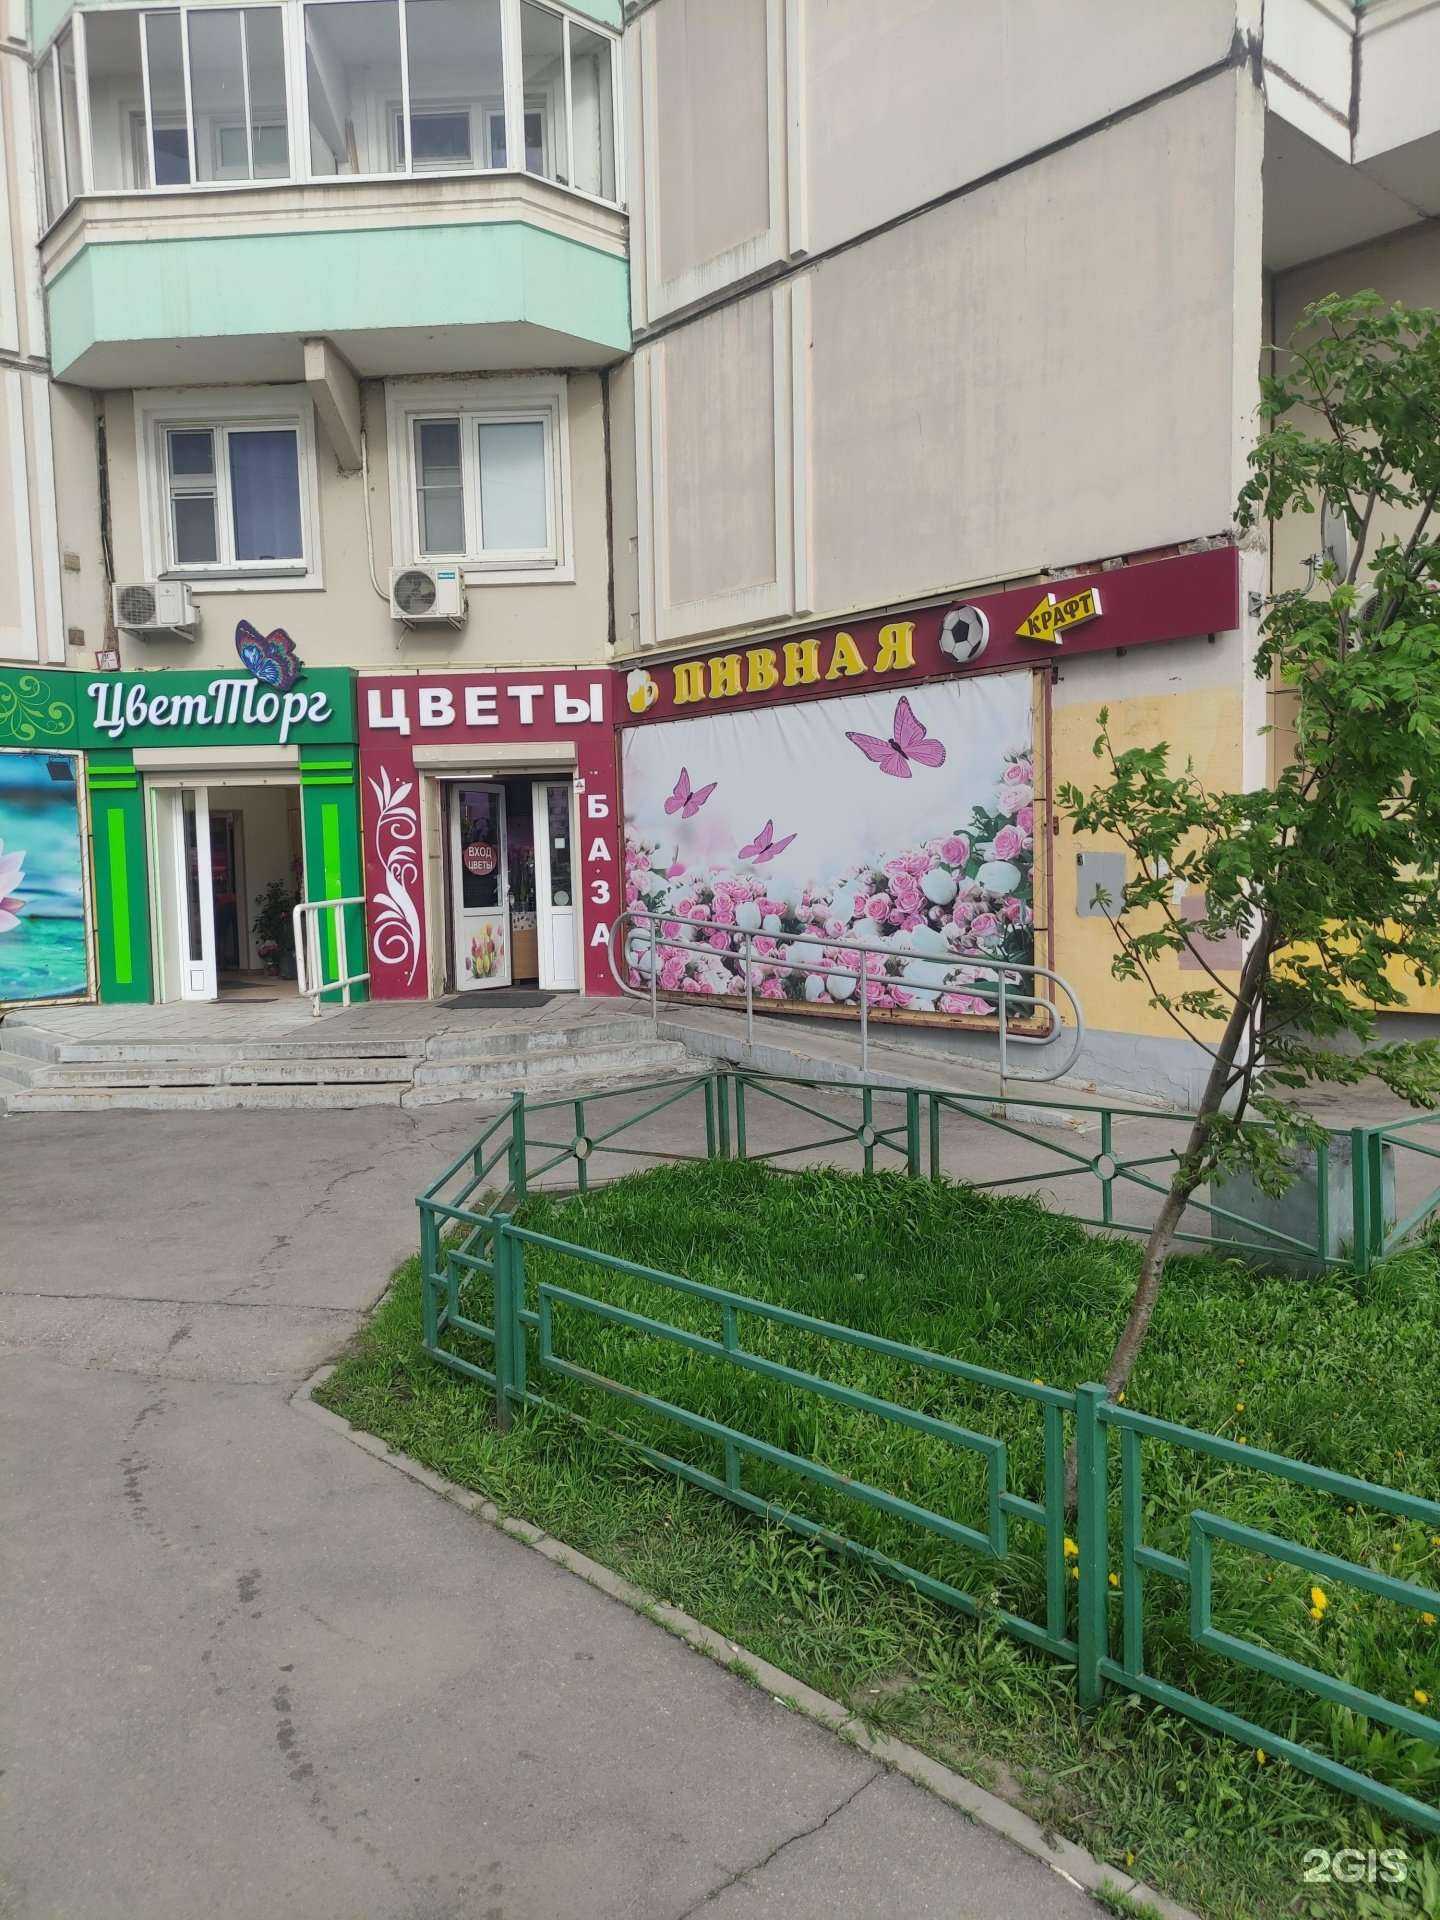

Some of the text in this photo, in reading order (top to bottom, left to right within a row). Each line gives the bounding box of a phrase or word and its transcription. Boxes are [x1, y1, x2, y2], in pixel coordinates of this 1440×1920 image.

[1027, 594, 1091, 635] КРАФТ
[672, 621, 916, 705] ПИВНАЯ
[88, 678, 333, 743] ЦветТорг
[367, 683, 604, 735] ЦВЕТЫ
[468, 846, 492, 859] ВХОД
[468, 860, 493, 870] ЦВЕТЫ
[587, 794, 612, 947] БАЗА
